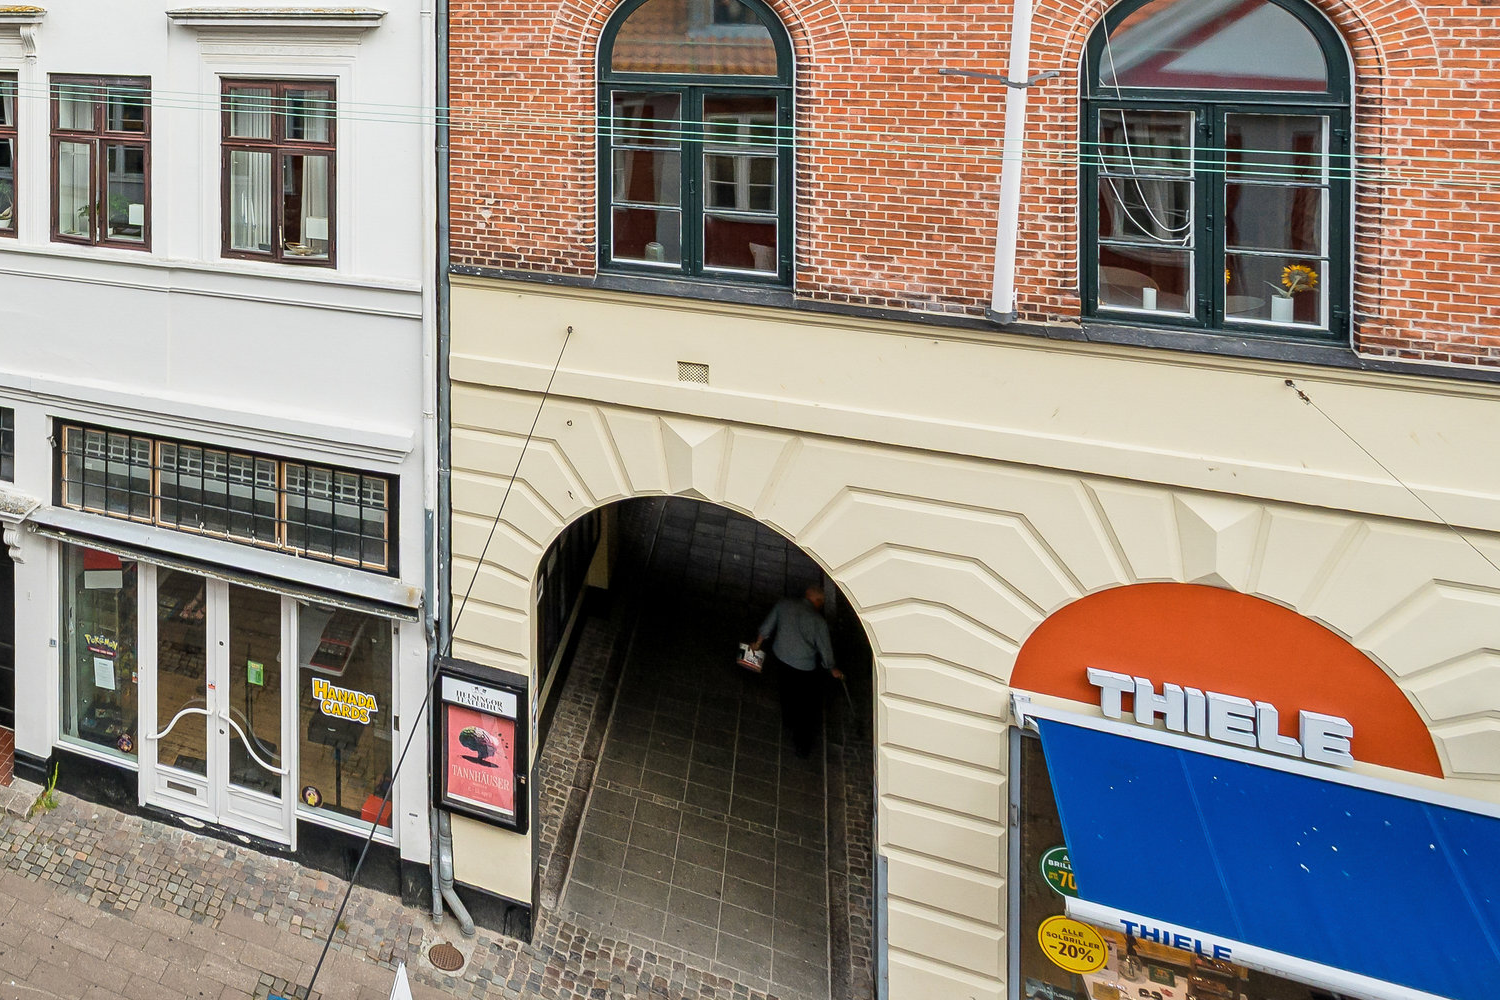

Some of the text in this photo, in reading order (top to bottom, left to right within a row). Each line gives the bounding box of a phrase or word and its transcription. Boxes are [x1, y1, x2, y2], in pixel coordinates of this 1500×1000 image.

[313, 679, 376, 710] HANADA
[322, 700, 369, 723] CARDS
[1086, 667, 1354, 768] THIELE
[452, 764, 510, 791] TANNHÄUSER
[1048, 859, 1073, 871] BRILL
[1046, 931, 1100, 950] SOLBRILLER
[1062, 927, 1083, 937] ALLE
[1120, 919, 1232, 962] THIELE
[1049, 942, 1094, 963] -20%
